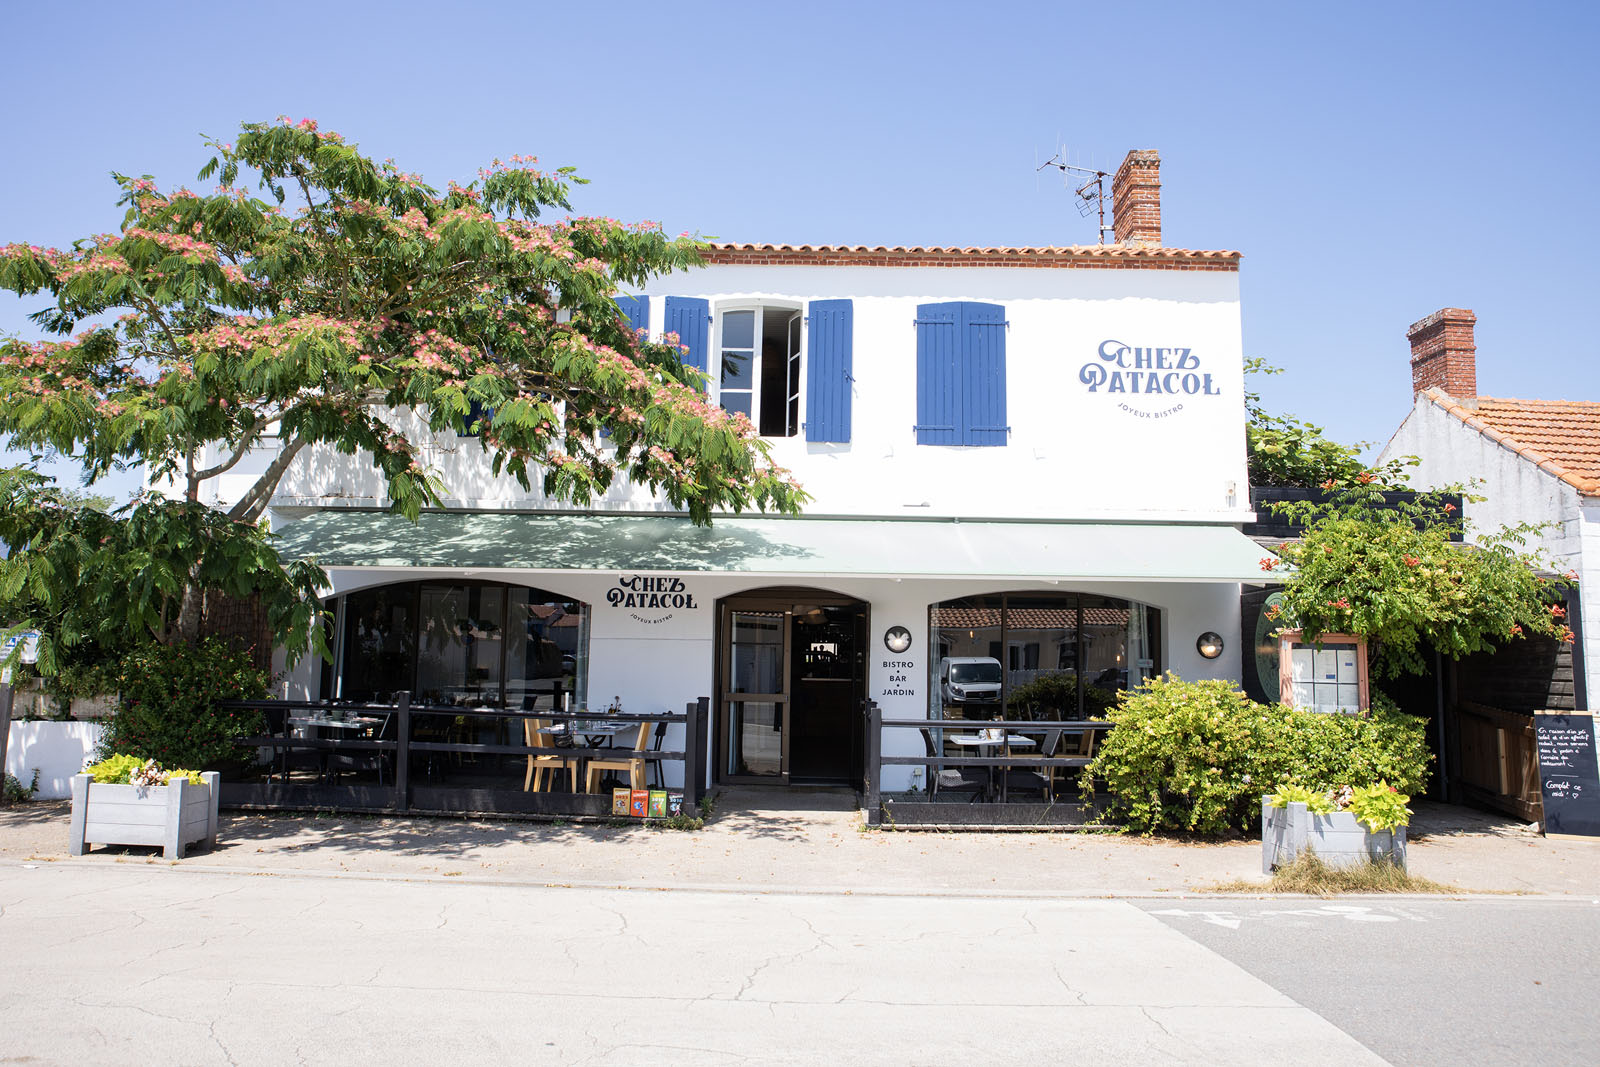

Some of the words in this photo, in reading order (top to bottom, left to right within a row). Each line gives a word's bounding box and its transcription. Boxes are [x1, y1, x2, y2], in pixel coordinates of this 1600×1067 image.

[1098, 339, 1200, 370] CHEZ
[1118, 402, 1151, 418] JOYEUX
[1154, 403, 1184, 419] BISTRO
[619, 574, 686, 592] CHEZ
[630, 612, 651, 624] JOYEUX
[653, 613, 673, 624] BISTRO
[1546, 780, 1570, 790] Complet
